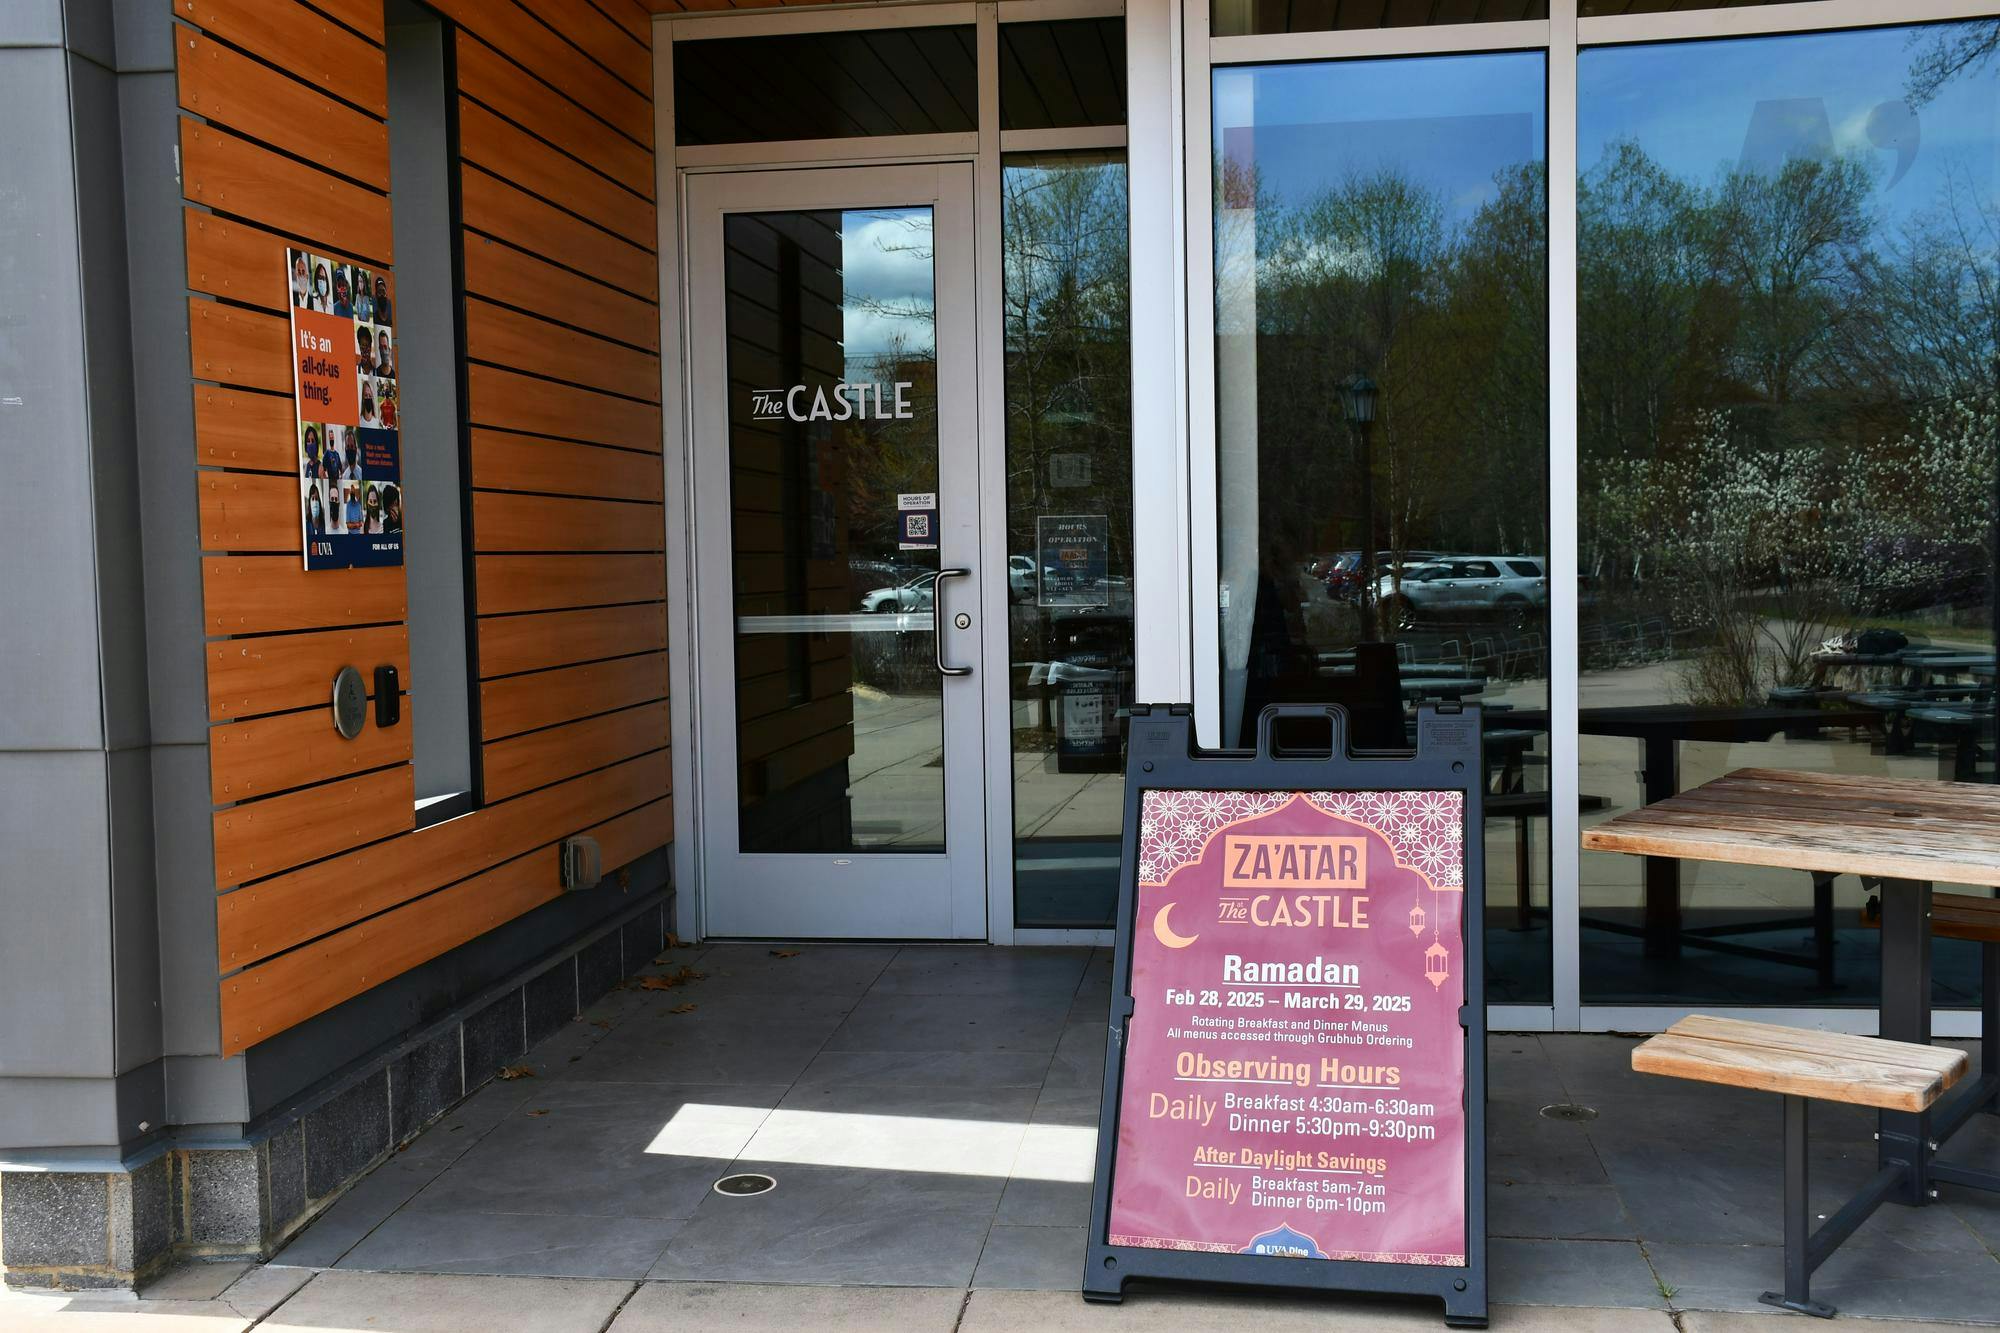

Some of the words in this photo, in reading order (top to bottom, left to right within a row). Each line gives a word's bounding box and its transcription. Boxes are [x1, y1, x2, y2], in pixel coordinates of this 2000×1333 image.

[300, 329, 317, 351] It's
[319, 337, 332, 353] an
[302, 356, 340, 379] all-of-us
[303, 381, 332, 406] thing.
[752, 394, 784, 415] The
[786, 382, 914, 422] CASTLE
[318, 542, 333, 556] UVA
[372, 543, 380, 551] FOR
[1232, 843, 1358, 881] ZA'ATAR
[1218, 901, 1248, 919] The
[1250, 894, 1370, 929] CASTLE
[1223, 954, 1359, 985] Ramadan
[1166, 989, 1195, 1005] Feb
[1199, 990, 1222, 1008] 28,
[1226, 992, 1265, 1008] 2025
[1284, 992, 1340, 1010] March
[1344, 994, 1368, 1012] 29,
[1372, 995, 1411, 1012] 2025
[1191, 1016, 1235, 1030] Rotating
[1237, 1017, 1288, 1030] Breakfast
[1290, 1019, 1310, 1030] and
[1313, 1020, 1348, 1032] Dinner
[1351, 1020, 1388, 1033] Menus
[1167, 1027, 1181, 1038] All
[1183, 1030, 1218, 1040] menus
[1220, 1029, 1271, 1042] accessed
[1273, 1032, 1314, 1045] through
[1317, 1033, 1363, 1045] Grubhub
[1366, 1034, 1413, 1048] Ordering
[1176, 1051, 1311, 1087] Observing
[1320, 1057, 1401, 1085] Hours
[1149, 1092, 1217, 1127] Daily
[1224, 1093, 1305, 1112] Breakfast
[1308, 1096, 1434, 1116] 4:30am-6:30am
[1229, 1113, 1291, 1134] Dinner
[1295, 1117, 1435, 1143] 5:30pm-9:30pm
[1194, 1146, 1236, 1164] After
[1240, 1148, 1313, 1171] Daylight
[1317, 1151, 1387, 1175] Savings
[1186, 1175, 1242, 1205] Daily
[1252, 1176, 1319, 1193] Breakfast
[1321, 1179, 1386, 1196] 5am-7am
[1252, 1191, 1302, 1208] Dinner
[1306, 1194, 1386, 1216] 6pm-10pm
